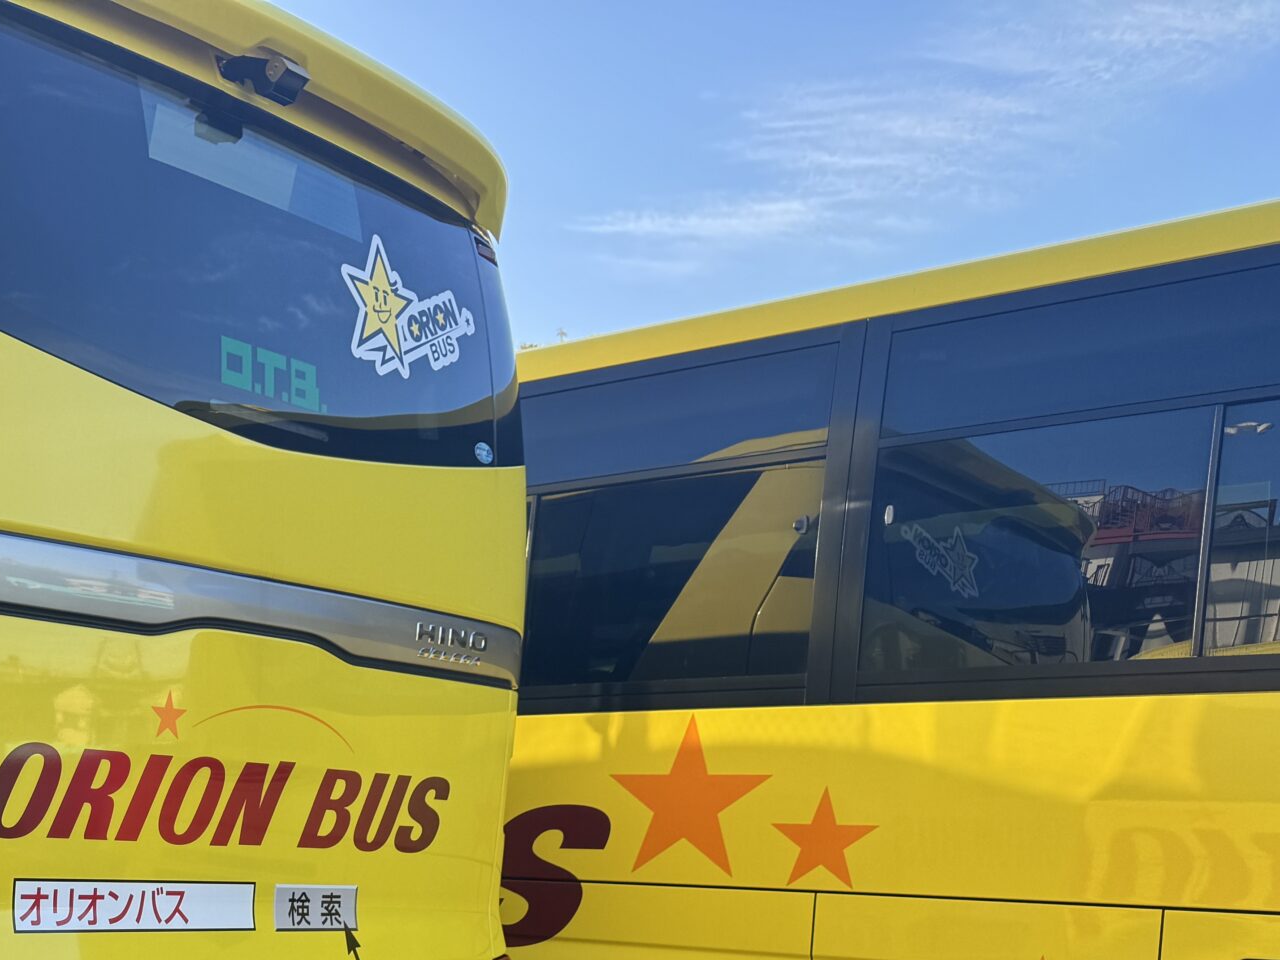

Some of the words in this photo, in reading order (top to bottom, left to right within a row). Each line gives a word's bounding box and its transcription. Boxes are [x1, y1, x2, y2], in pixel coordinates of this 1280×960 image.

[407, 298, 459, 343] ORION
[429, 335, 456, 362] BUS
[416, 622, 487, 652] HINO
[297, 768, 450, 853] BUS
[19, 886, 190, 927] オリオンバス
[287, 891, 343, 927] 検索
